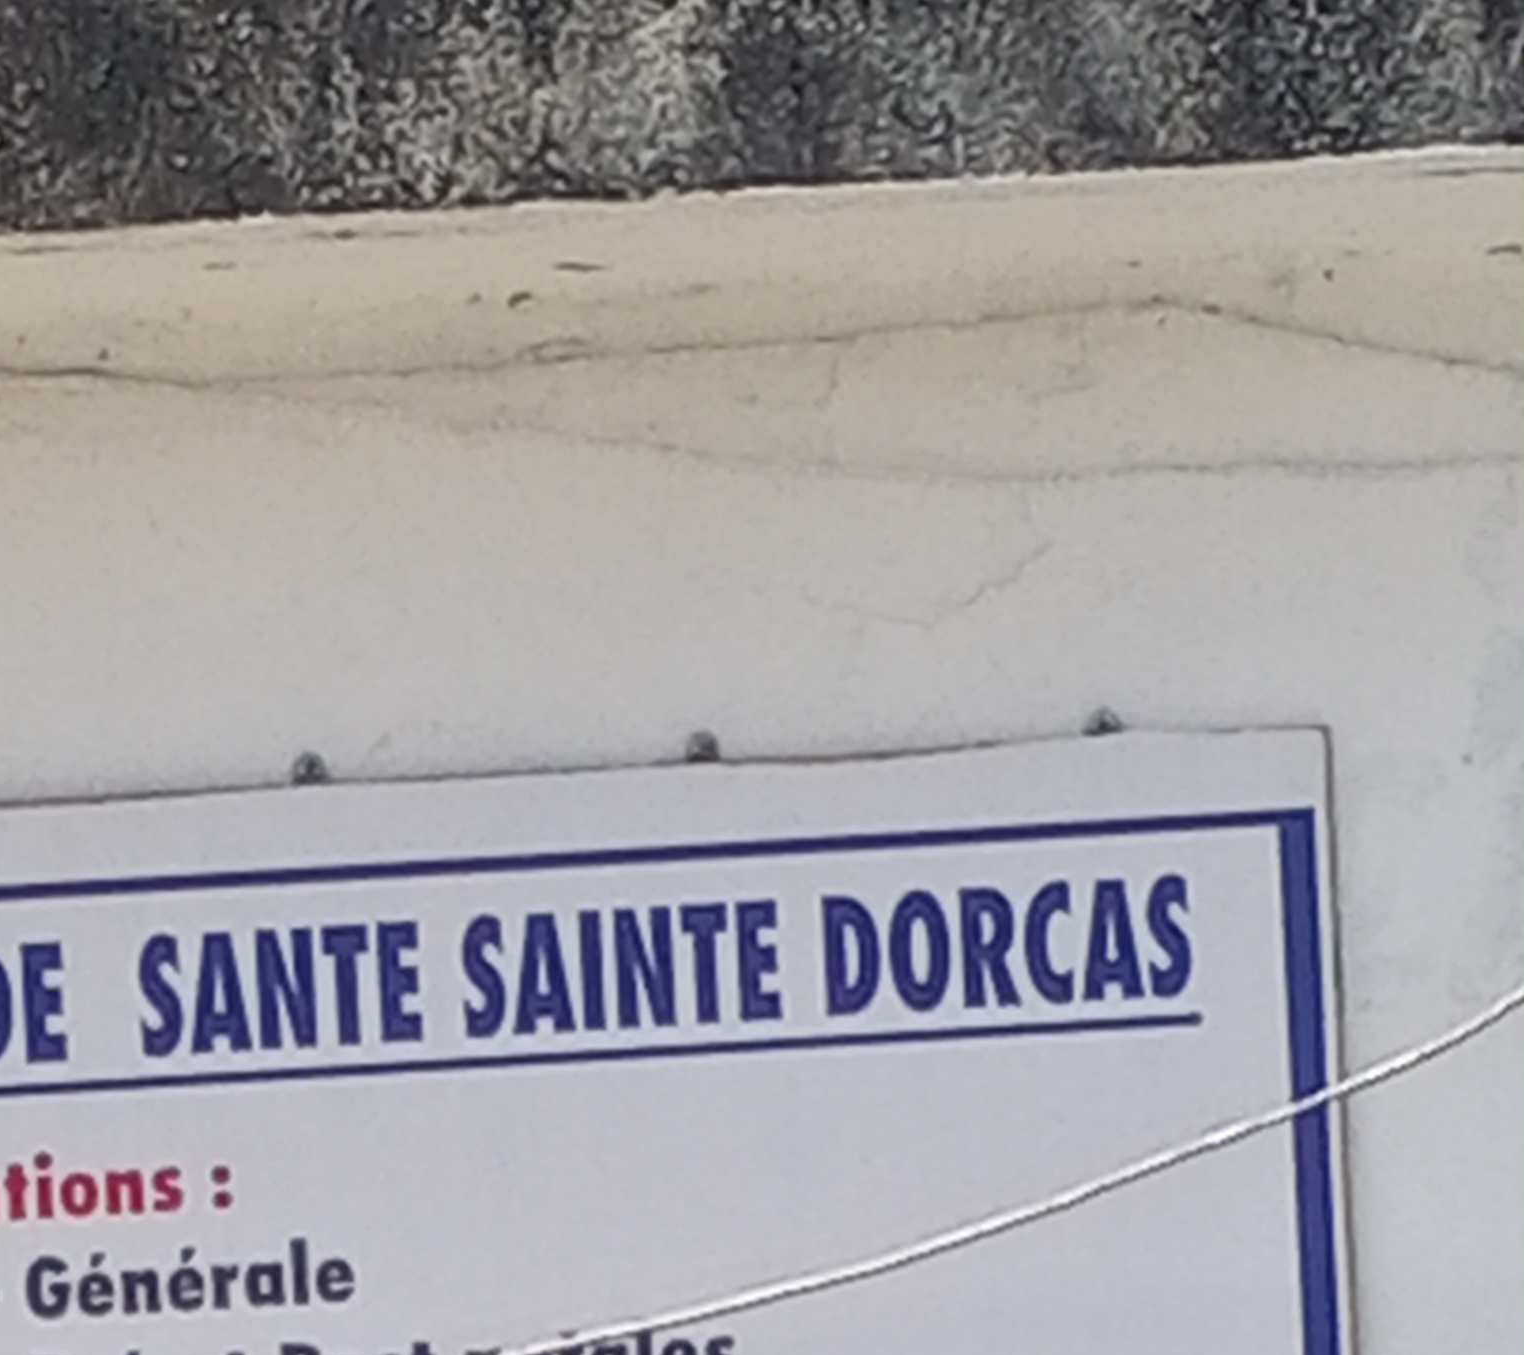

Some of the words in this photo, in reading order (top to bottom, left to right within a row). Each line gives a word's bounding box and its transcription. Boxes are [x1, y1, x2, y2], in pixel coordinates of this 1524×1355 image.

[138, 920, 423, 1058] SANTE
[462, 899, 783, 1039] SAINTE
[821, 874, 1193, 1016] DORCAS
[25, 1237, 355, 1320] Générale
